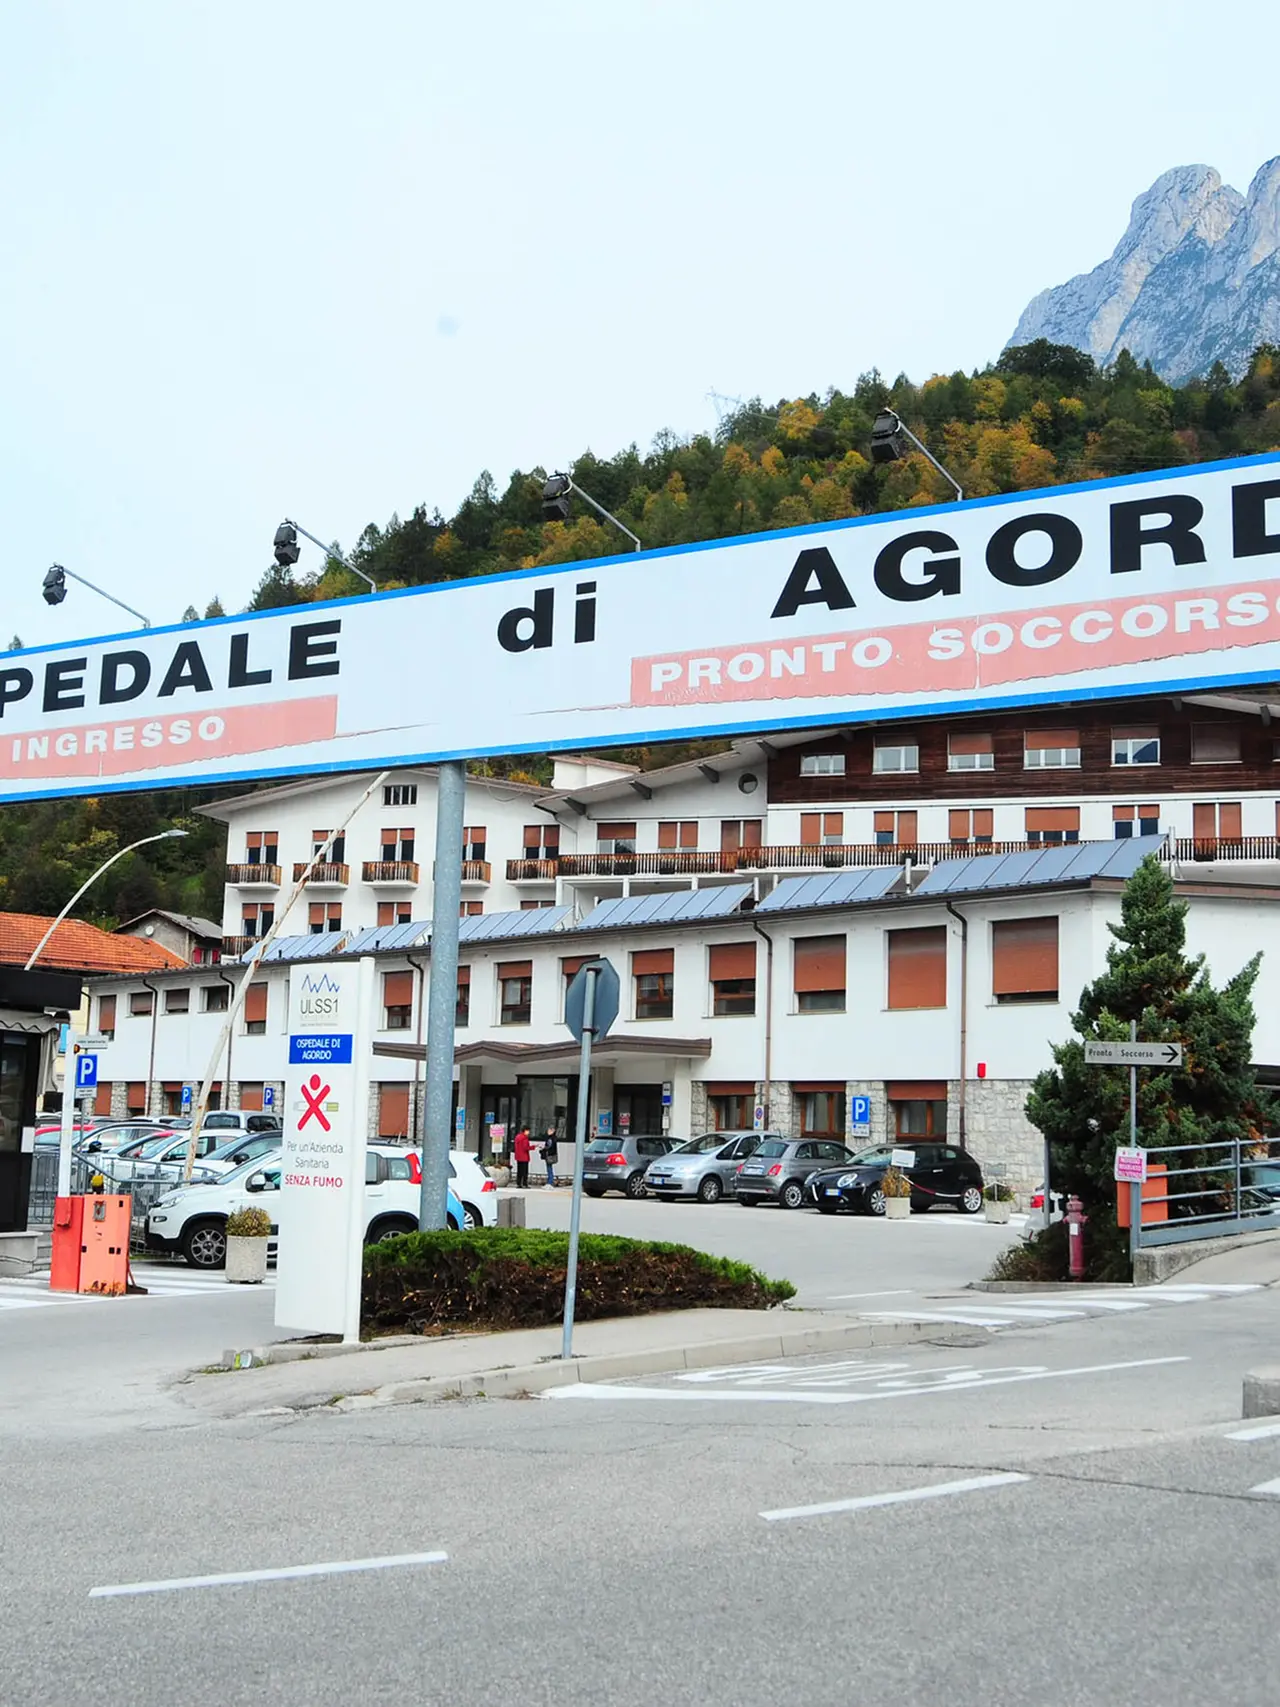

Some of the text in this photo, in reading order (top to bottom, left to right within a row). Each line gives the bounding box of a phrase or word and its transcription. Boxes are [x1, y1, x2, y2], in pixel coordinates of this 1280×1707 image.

[0, 619, 341, 718] PEDALE
[497, 581, 598, 653] di
[650, 592, 1280, 693] PRONTO SOCCORS
[12, 716, 225, 763] INGRESSO
[300, 998, 338, 1015] ULSS1
[296, 1038, 341, 1049] OSPEDALE DI
[302, 1049, 332, 1060] AGORDO
[1088, 1048, 1154, 1058] Pronto Soccorso
[80, 1058, 94, 1084] P
[855, 1098, 866, 1120] P
[295, 1157, 330, 1169] Sanitaria
[285, 1174, 344, 1188] SENZA FUMO
